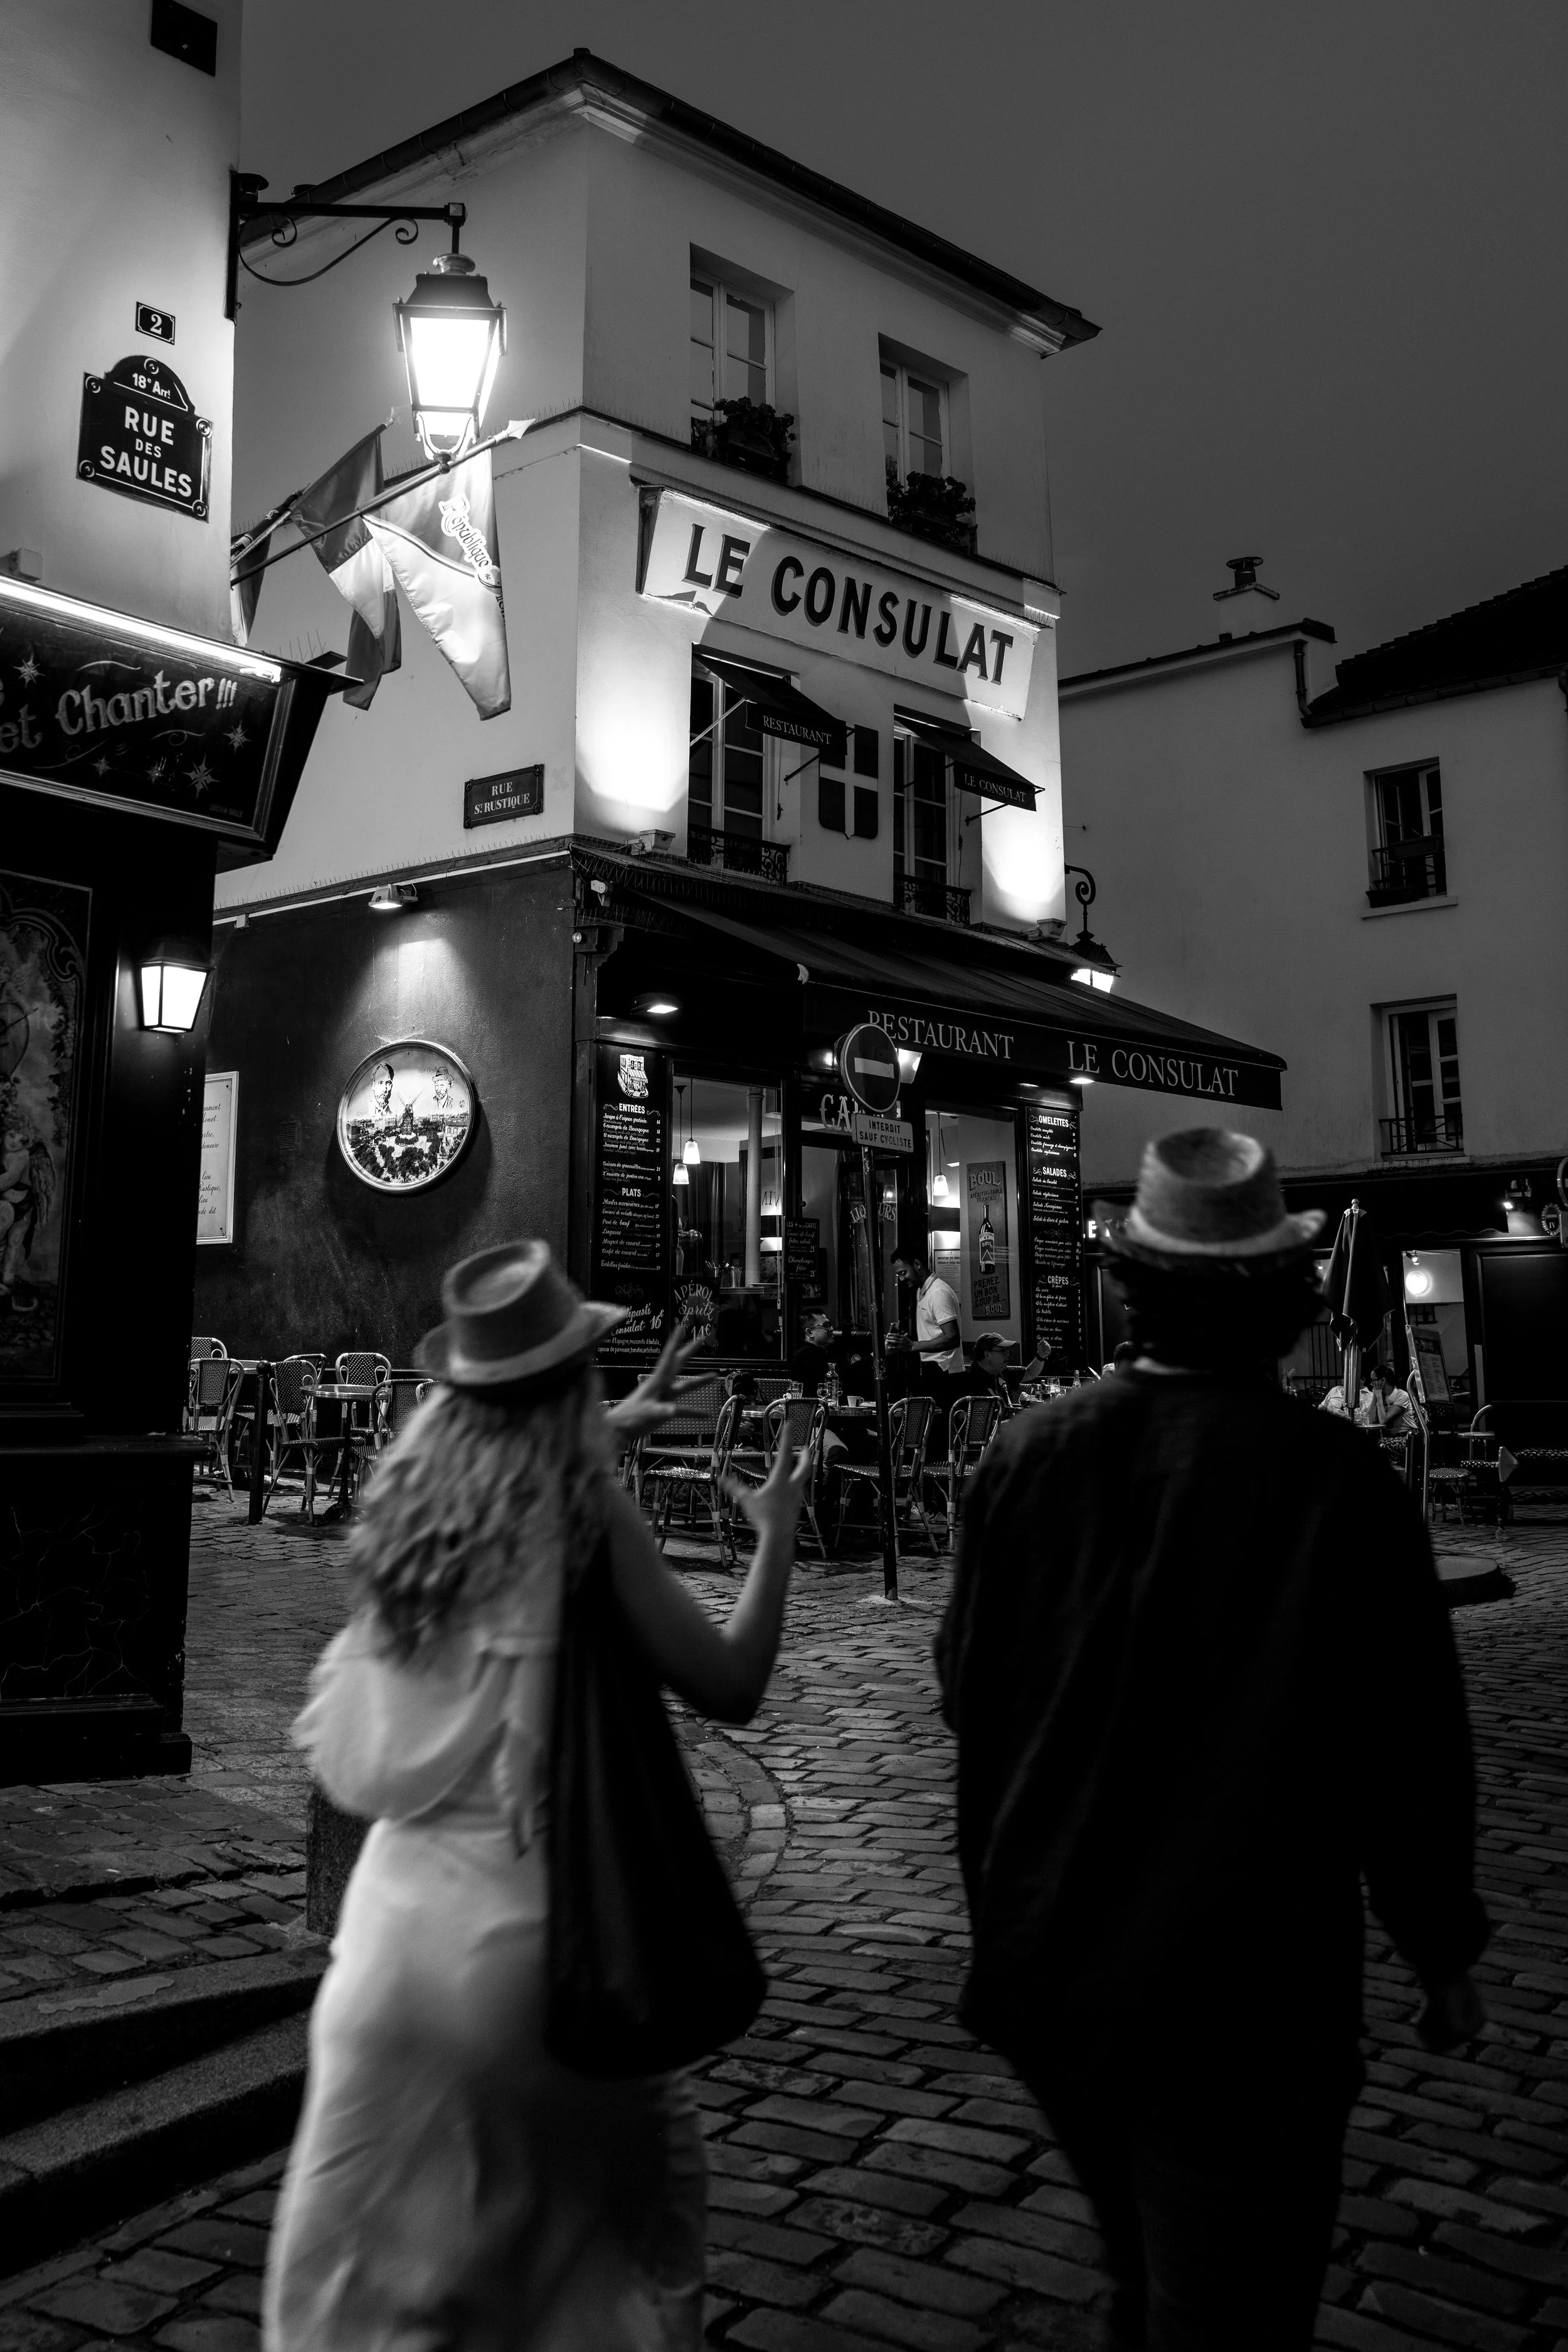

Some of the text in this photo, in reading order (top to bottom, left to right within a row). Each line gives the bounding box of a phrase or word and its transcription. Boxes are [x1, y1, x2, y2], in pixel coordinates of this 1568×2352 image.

[150, 314, 162, 334] 2
[125, 406, 174, 446] RUE
[135, 438, 162, 458] DES
[100, 445, 193, 497] SAULES
[681, 523, 1014, 686] LE CONSULAT
[763, 715, 832, 744] RESTAURANT
[492, 781, 512, 797] RUE
[964, 773, 1026, 802] LE CONSULAT
[484, 793, 530, 813] RUSTIQUE
[867, 1010, 1239, 1097] RESTAURANT LE CONSULAT
[203, 1103, 221, 1111] mment
[619, 1103, 645, 1114] ENTRÉES
[869, 1120, 901, 1134] INTERDIT
[1039, 1115, 1069, 1128] OMELETTES
[859, 1131, 911, 1148] SAUF CYCLISTE
[202, 1170, 211, 1180] lieu
[1042, 1167, 1067, 1178] SALADES
[199, 1194, 208, 1203] lieu
[622, 1187, 641, 1197] PLATS
[850, 1202, 896, 1224] LIQURS
[974, 1276, 1000, 1289] PRENEZ
[1047, 1274, 1069, 1285] CRÊPES
[674, 1279, 714, 1305] APÉROL
[974, 1286, 998, 1298] UN BON
[975, 1296, 991, 1307] COUP
[626, 1303, 652, 1323] tipasti
[679, 1300, 715, 1327] Spritz
